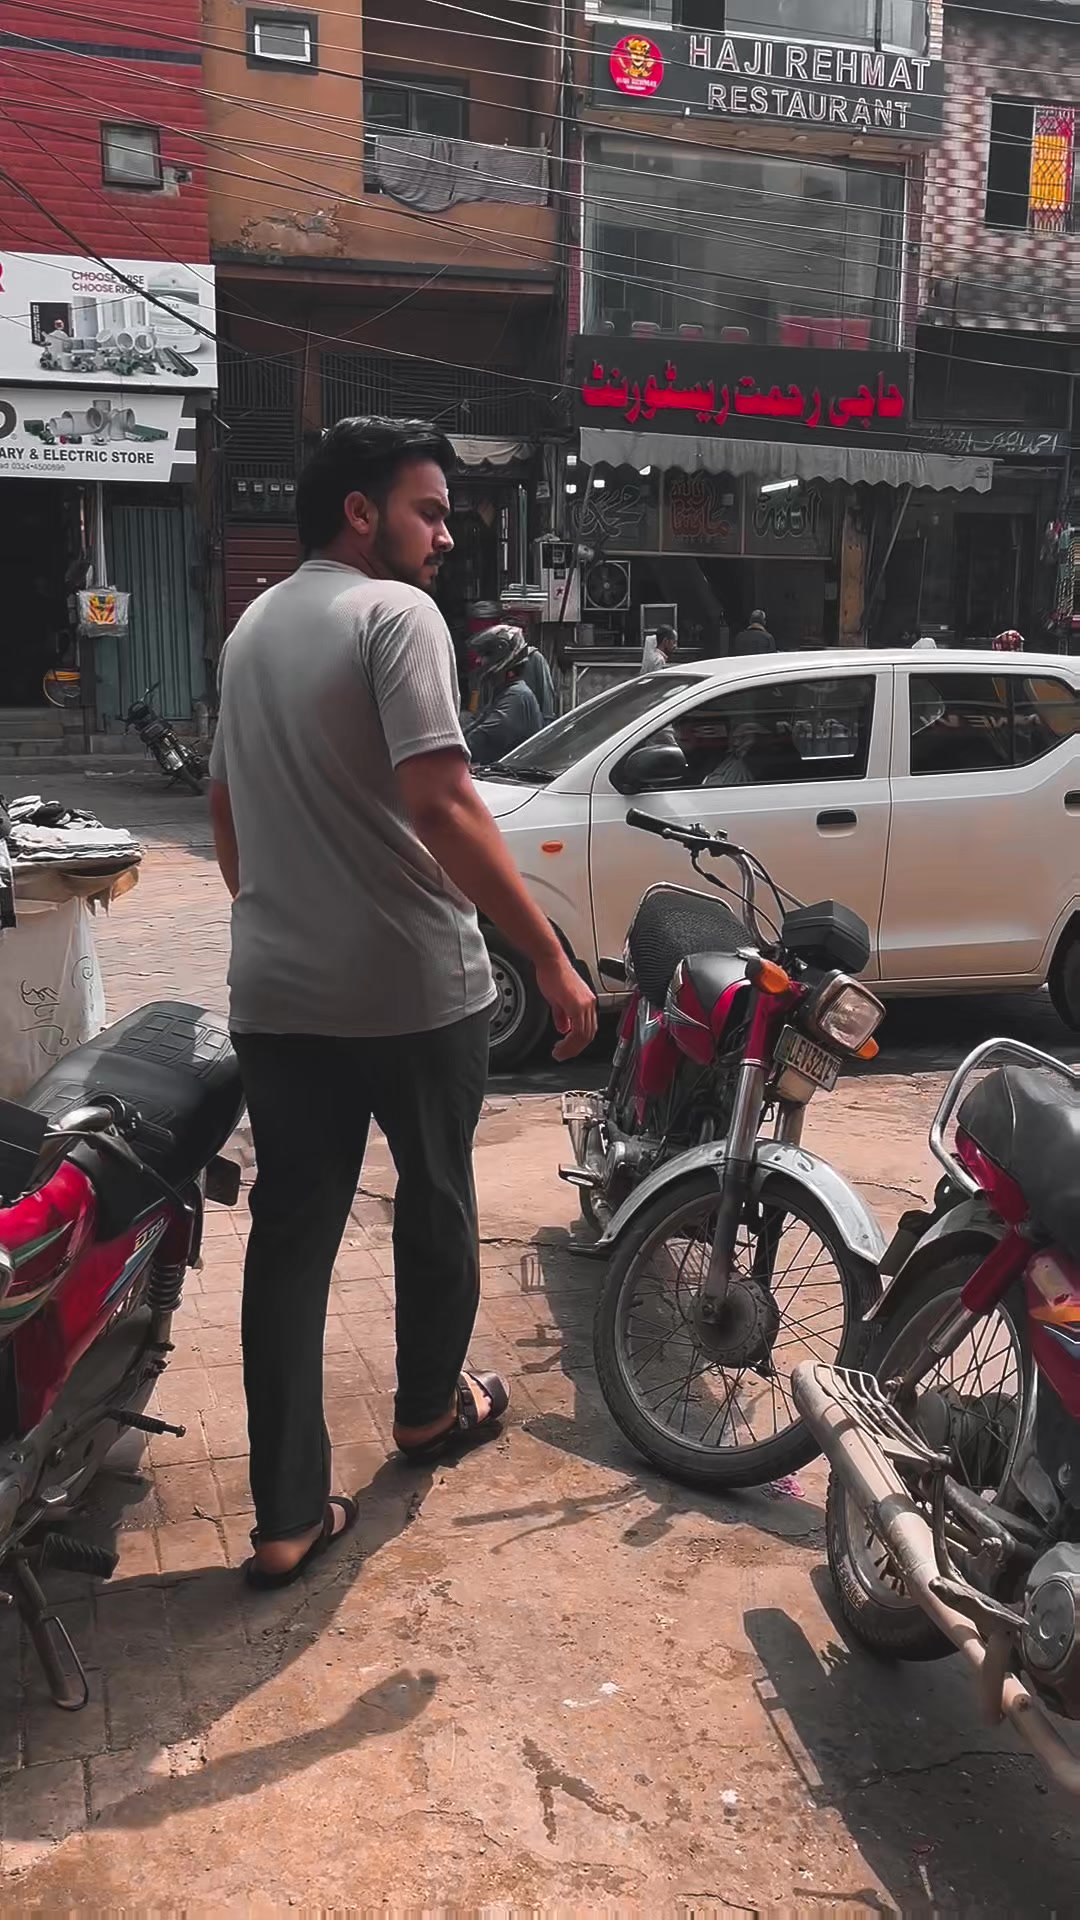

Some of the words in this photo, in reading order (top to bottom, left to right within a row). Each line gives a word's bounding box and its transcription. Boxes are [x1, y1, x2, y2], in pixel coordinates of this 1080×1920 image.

[689, 35, 773, 75] HAJI
[785, 45, 931, 91] REHMAT
[707, 83, 912, 129] RESTAURANT
[72, 271, 117, 282] CHOOSE
[72, 283, 114, 293] CHOOSE
[581, 360, 730, 425] ریسٹورنٹ
[735, 376, 821, 428] رحمت
[829, 371, 905, 428] حاجی
[29, 449, 39, 460] &
[43, 450, 108, 463] ELECTRIC
[111, 451, 155, 464] STORE
